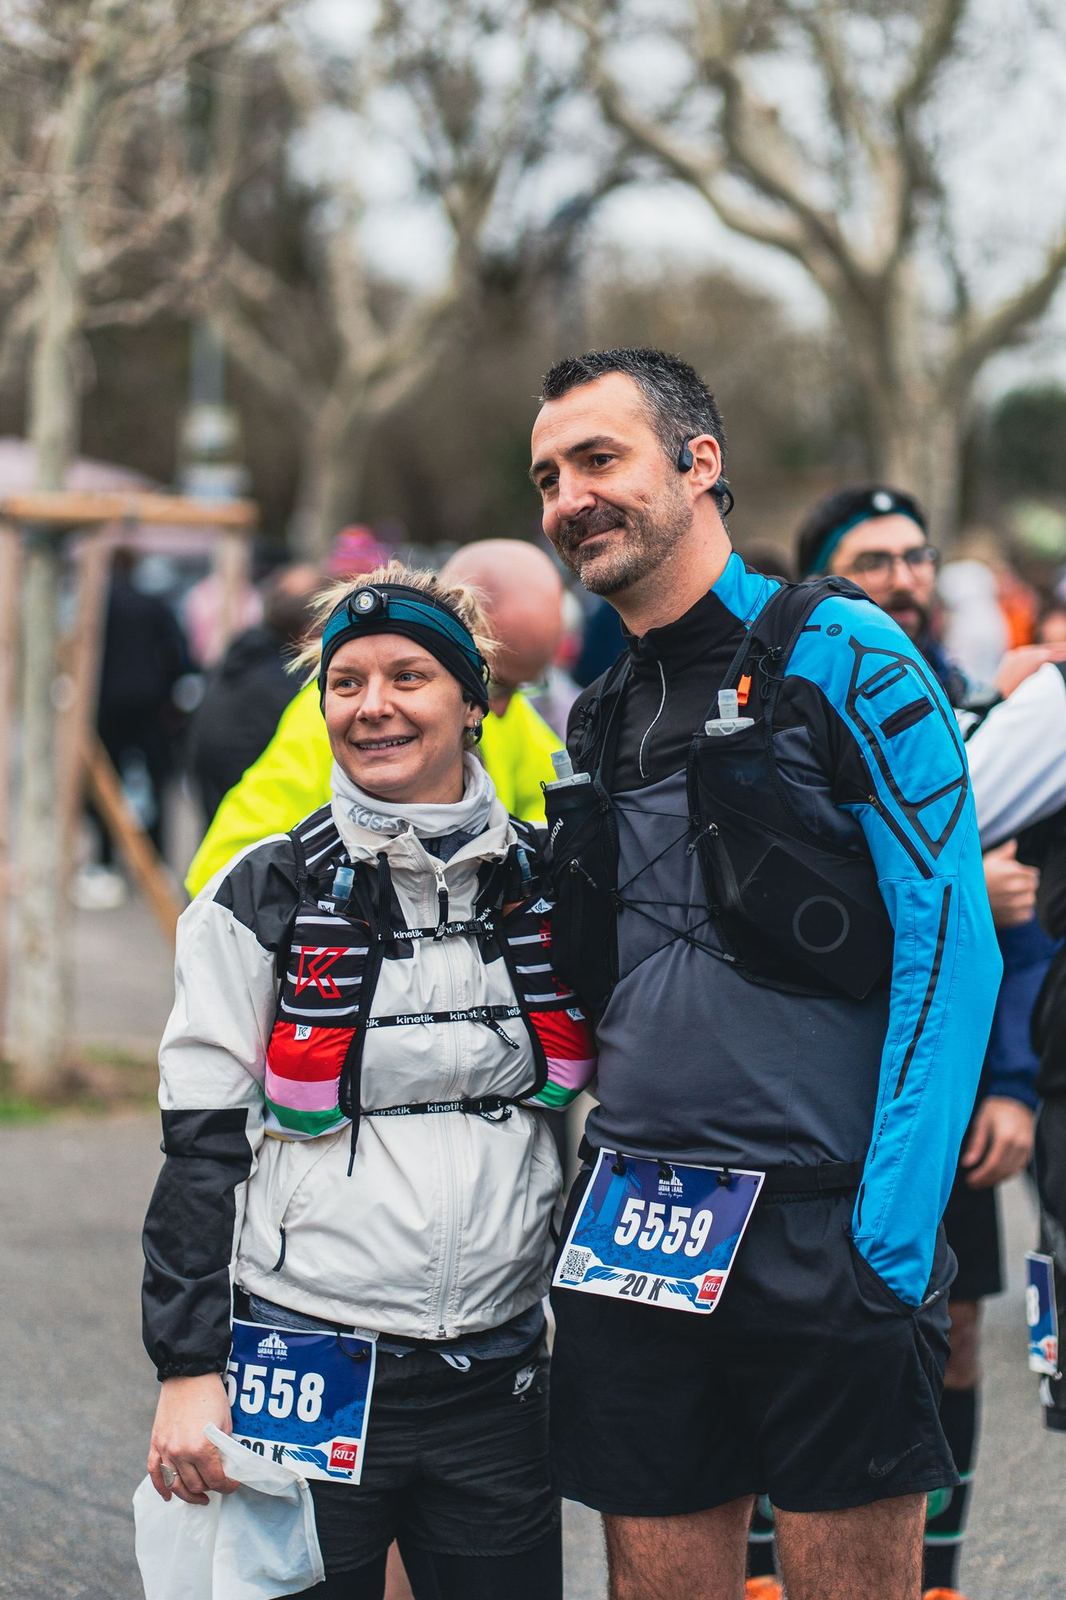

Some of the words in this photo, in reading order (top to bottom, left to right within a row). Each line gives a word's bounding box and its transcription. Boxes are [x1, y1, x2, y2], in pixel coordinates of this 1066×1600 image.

[393, 929, 424, 939] kinetik
[396, 1013, 434, 1025] kinetik
[449, 1009, 487, 1020] kinetk
[372, 1105, 411, 1116] kinetik
[427, 1102, 464, 1113] kinetik
[613, 1197, 713, 1258] 5559
[618, 1272, 648, 1298] 20
[647, 1277, 666, 1302] K
[702, 1282, 720, 1293] RTL2
[271, 1444, 286, 1466] K
[332, 1449, 356, 1462] RTL2
